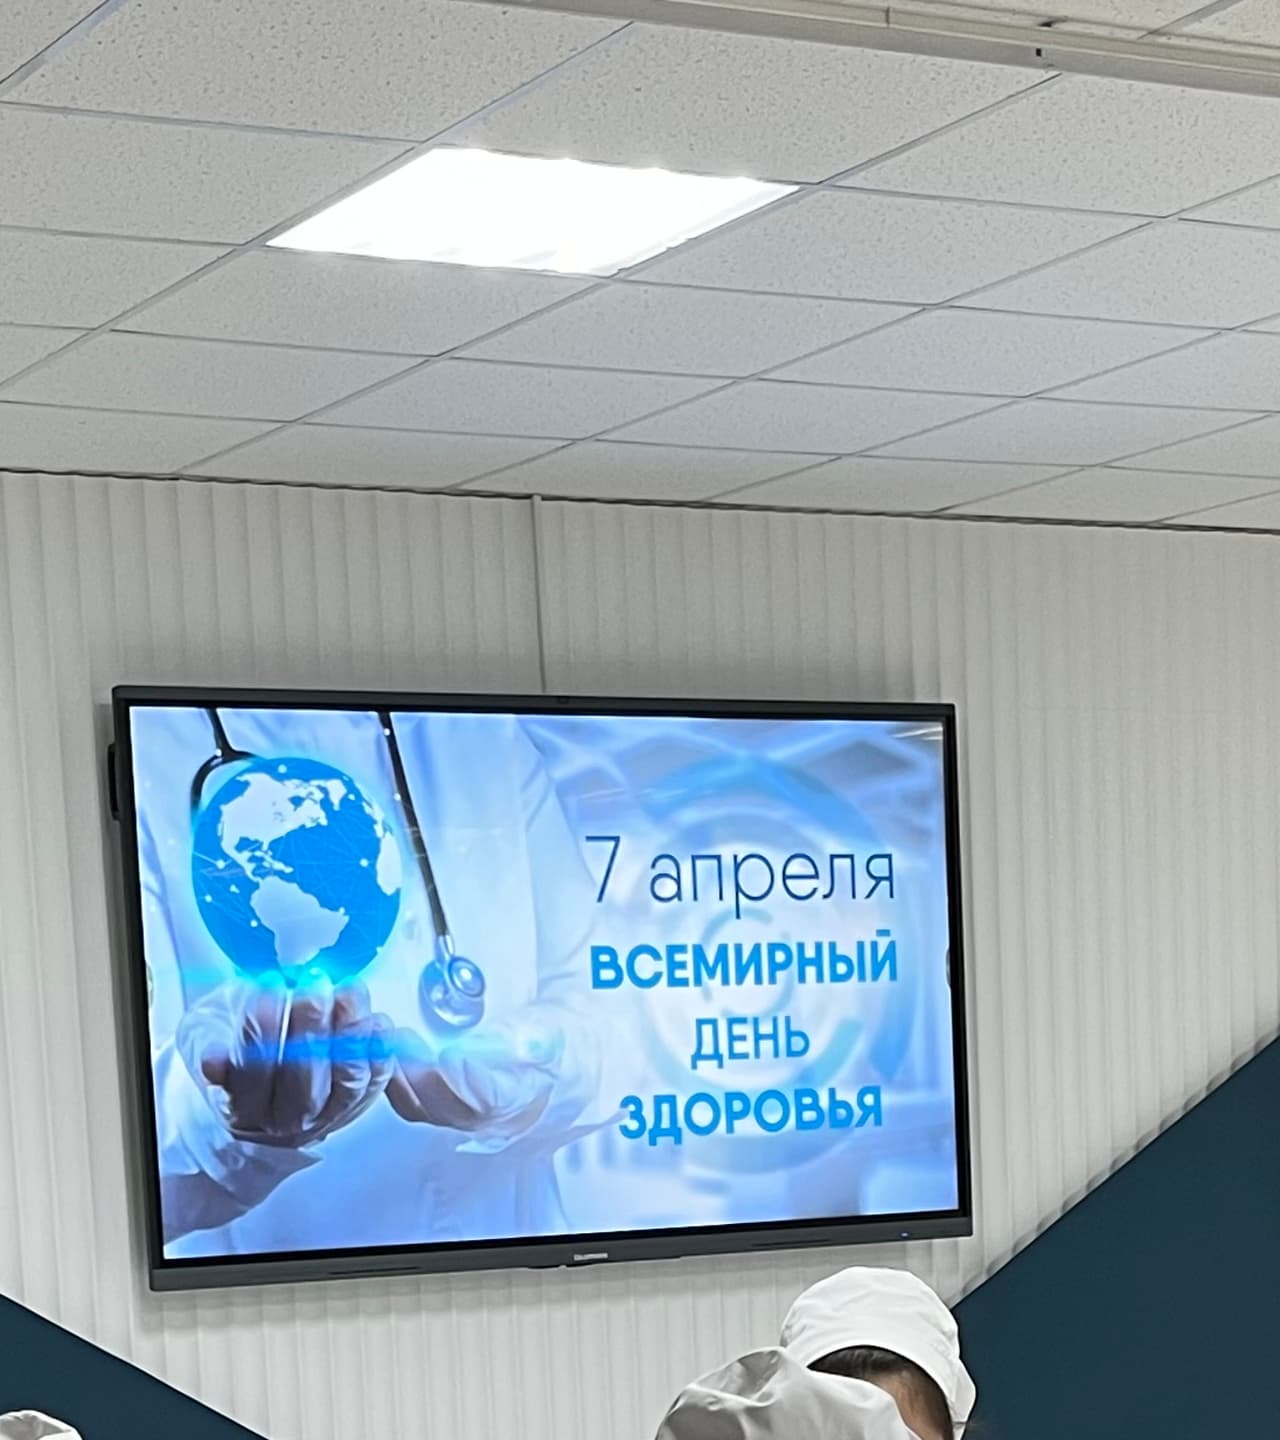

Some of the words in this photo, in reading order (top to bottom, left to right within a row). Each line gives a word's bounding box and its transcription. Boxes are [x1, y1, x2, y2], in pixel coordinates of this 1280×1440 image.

[585, 836, 620, 902] 7
[650, 853, 894, 920] апреля
[590, 929, 898, 989] ВСЕМИРНЫЙ
[691, 1016, 810, 1069] ДЕНЬ
[619, 1086, 882, 1146] ЗДОРОВЬЯ
